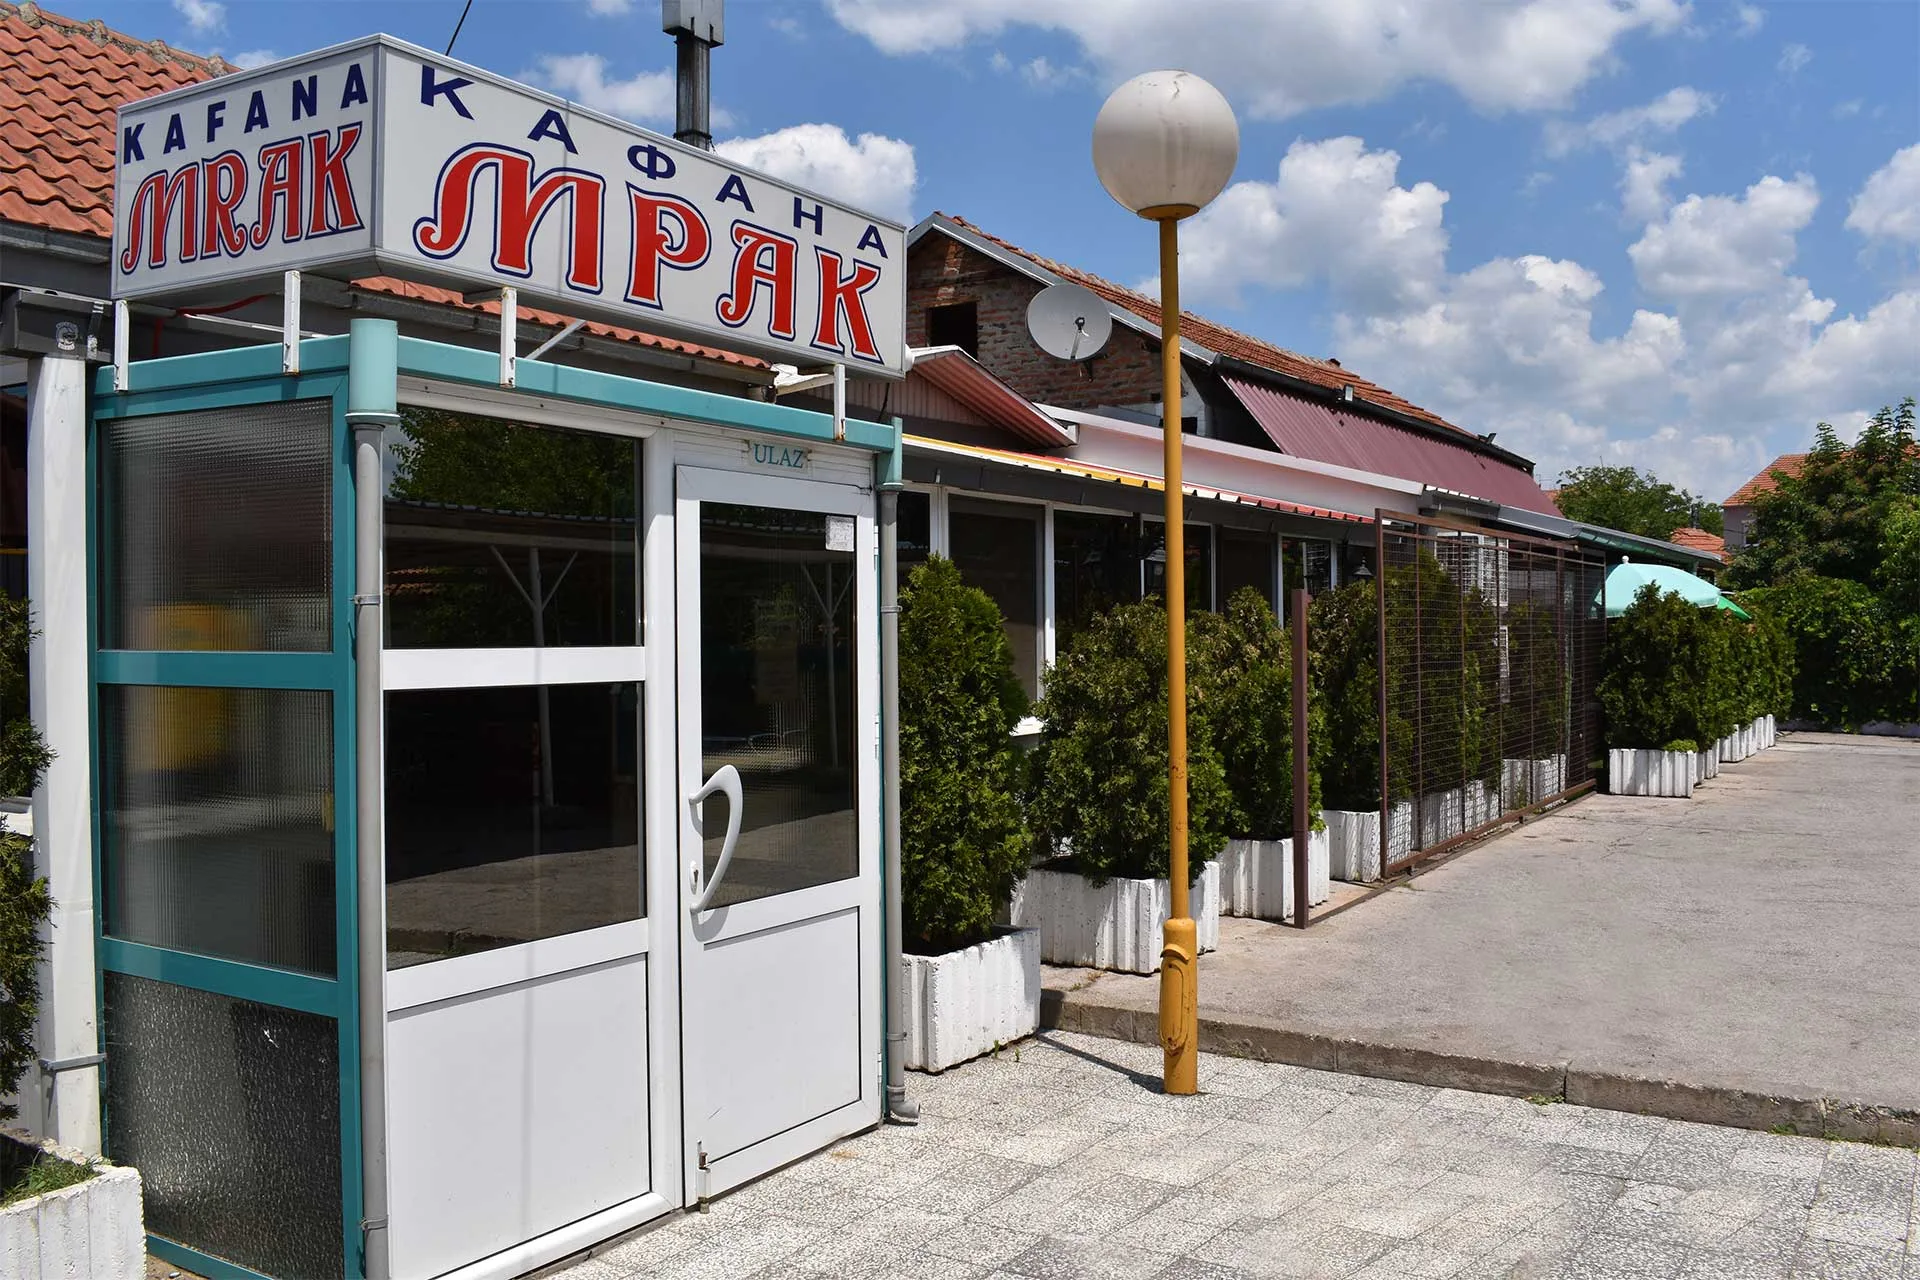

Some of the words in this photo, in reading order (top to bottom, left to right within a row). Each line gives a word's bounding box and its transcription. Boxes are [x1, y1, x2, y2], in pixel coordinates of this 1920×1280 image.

[124, 63, 368, 164] KAFANA
[421, 65, 888, 259] КАФАНА
[121, 121, 365, 274] MRAK
[413, 143, 883, 365] МРАК
[754, 443, 804, 468] ULAZ
